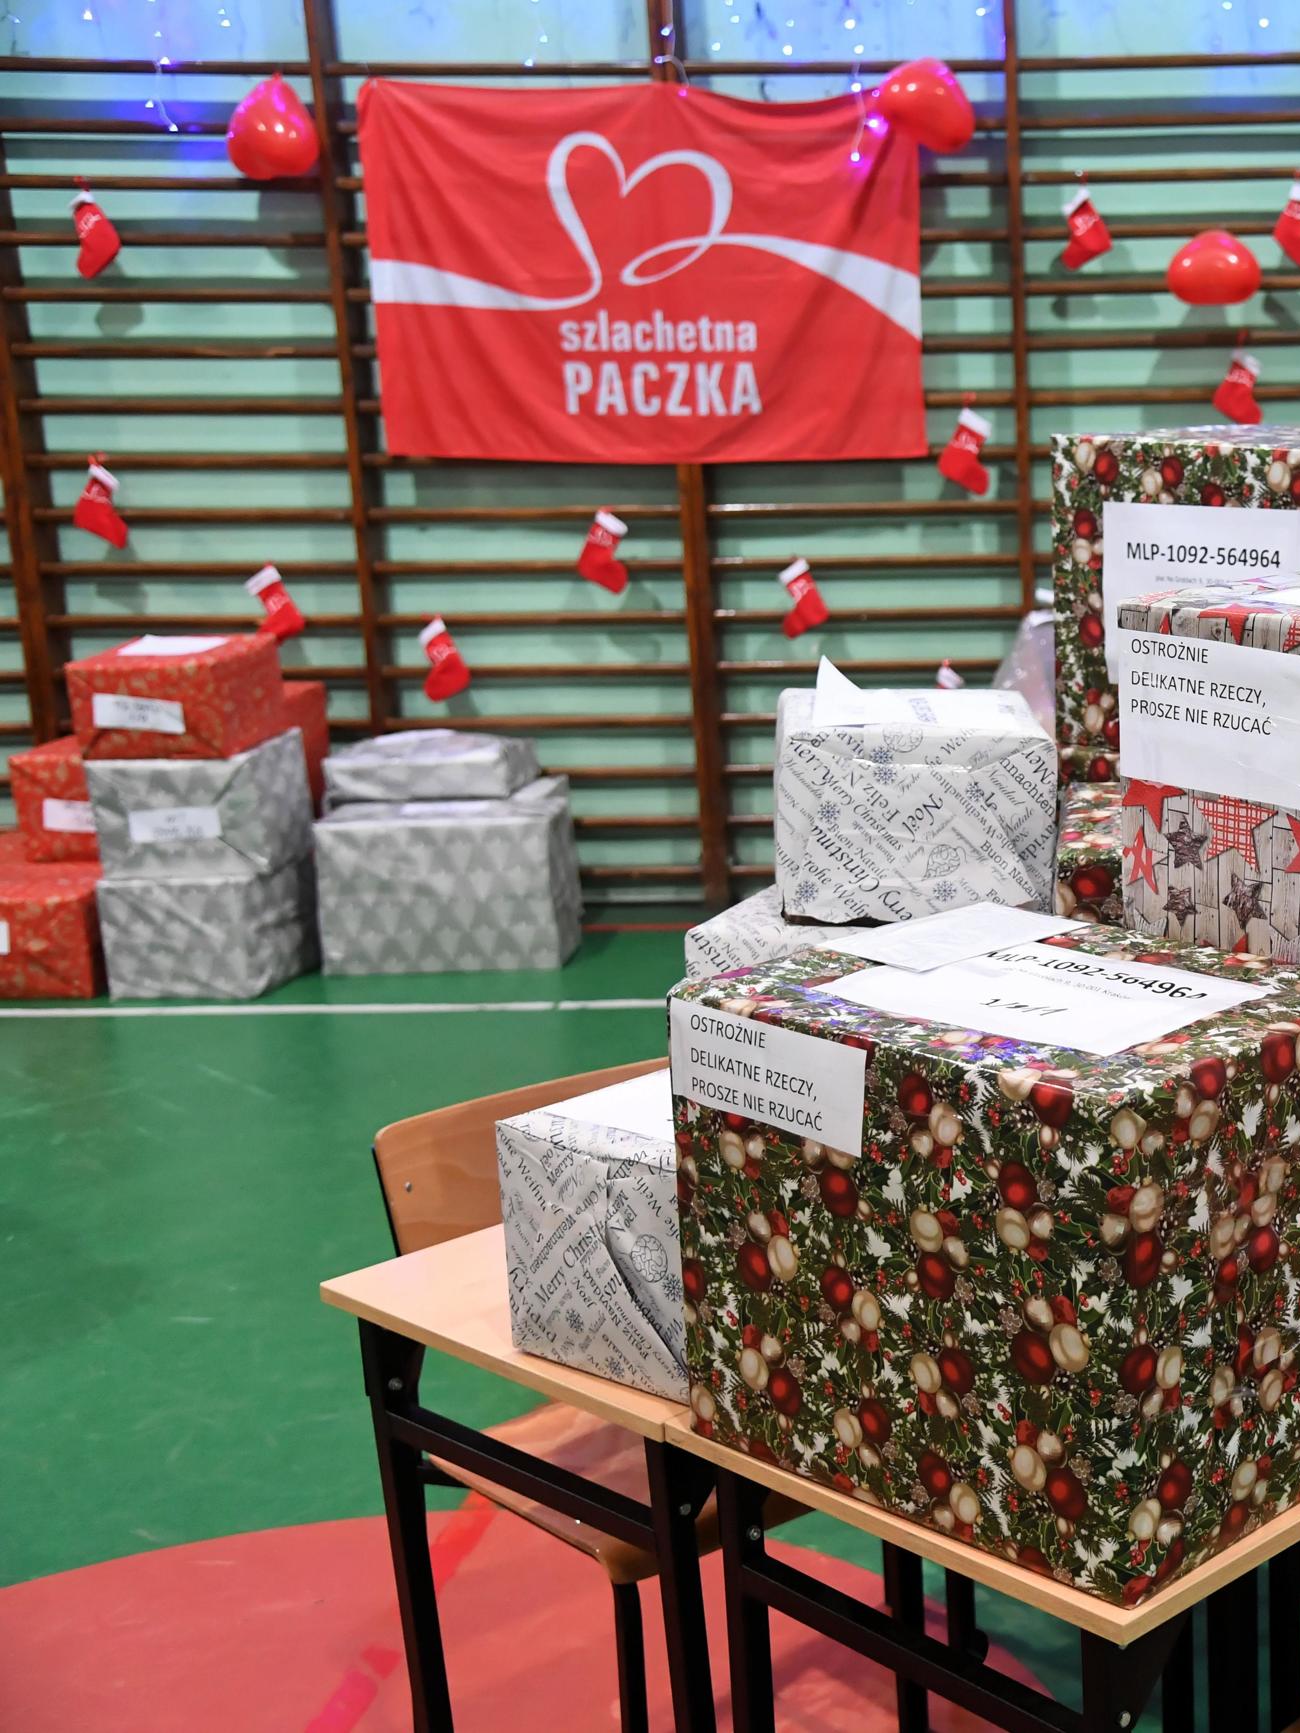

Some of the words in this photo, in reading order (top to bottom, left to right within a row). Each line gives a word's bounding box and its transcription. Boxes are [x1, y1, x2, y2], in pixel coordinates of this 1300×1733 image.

[559, 308, 759, 352] szlachetna
[562, 360, 763, 416] PACZKA
[1126, 541, 1281, 569] MLP-1092-564964
[1130, 638, 1209, 664] OSTROŻNIE
[1130, 670, 1206, 696] DELIKATNE
[1209, 682, 1267, 708] RZECZY,
[1130, 698, 1181, 721] PROSZE
[1185, 707, 1208, 726] NIE
[1212, 711, 1272, 736] RZUCAĆ
[901, 793, 944, 843] Noël
[981, 840, 1009, 870] Buon
[690, 1013, 767, 1050] OSTROŻNIE
[690, 1047, 762, 1083] DELIKATNE
[764, 1069, 818, 1102] RZECZY,
[691, 1076, 740, 1106] PROSZE
[742, 1092, 766, 1115] NIE
[768, 1101, 824, 1132] RZUCAĆ
[621, 1324, 651, 1361] Feliz
